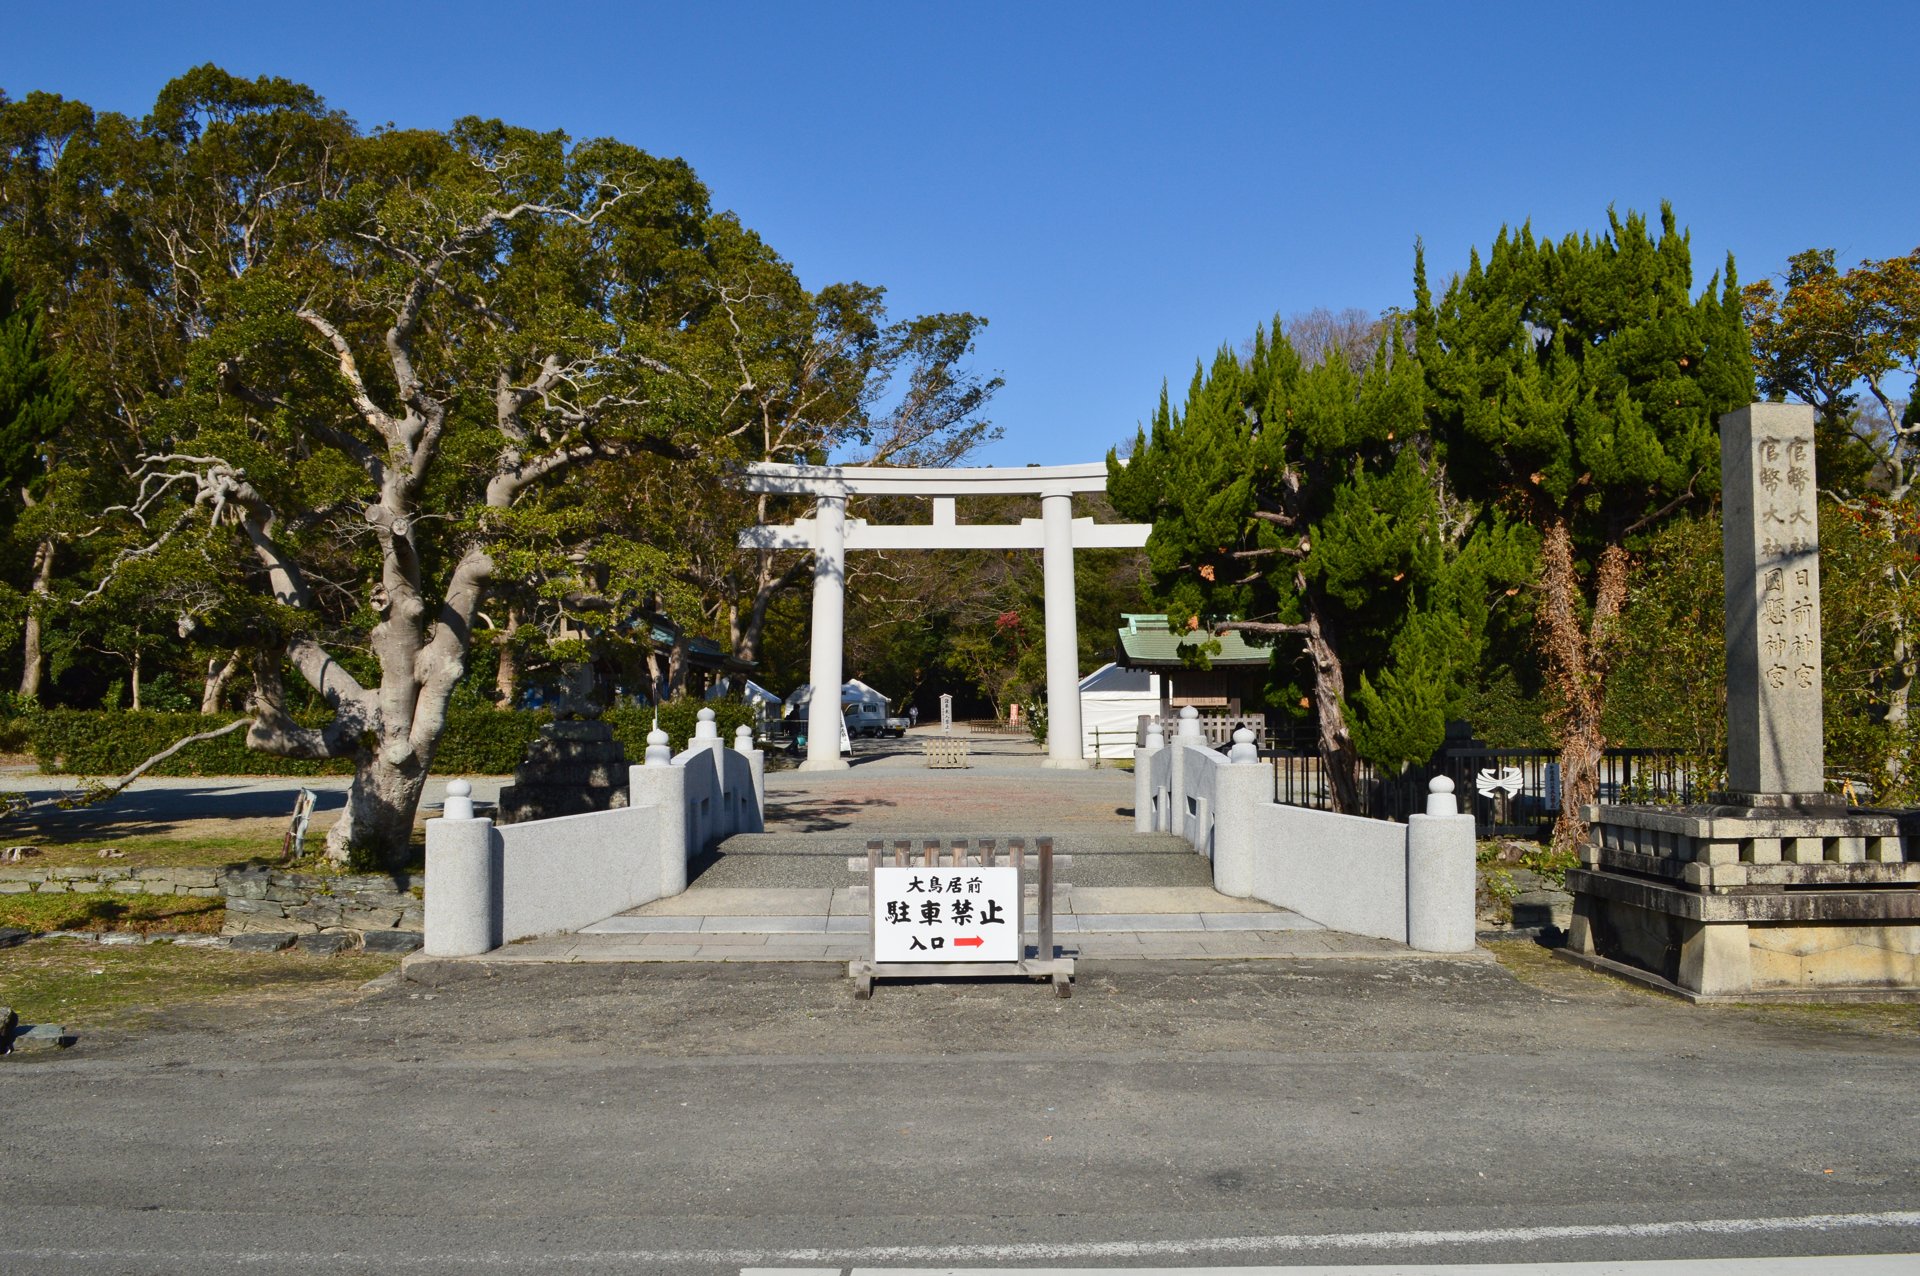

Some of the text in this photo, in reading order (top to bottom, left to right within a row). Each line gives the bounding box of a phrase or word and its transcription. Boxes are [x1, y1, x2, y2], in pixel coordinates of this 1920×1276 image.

[906, 876, 983, 894] 大鳥居前
[885, 899, 1005, 926] 駐車禁止
[909, 935, 945, 951] 入口
